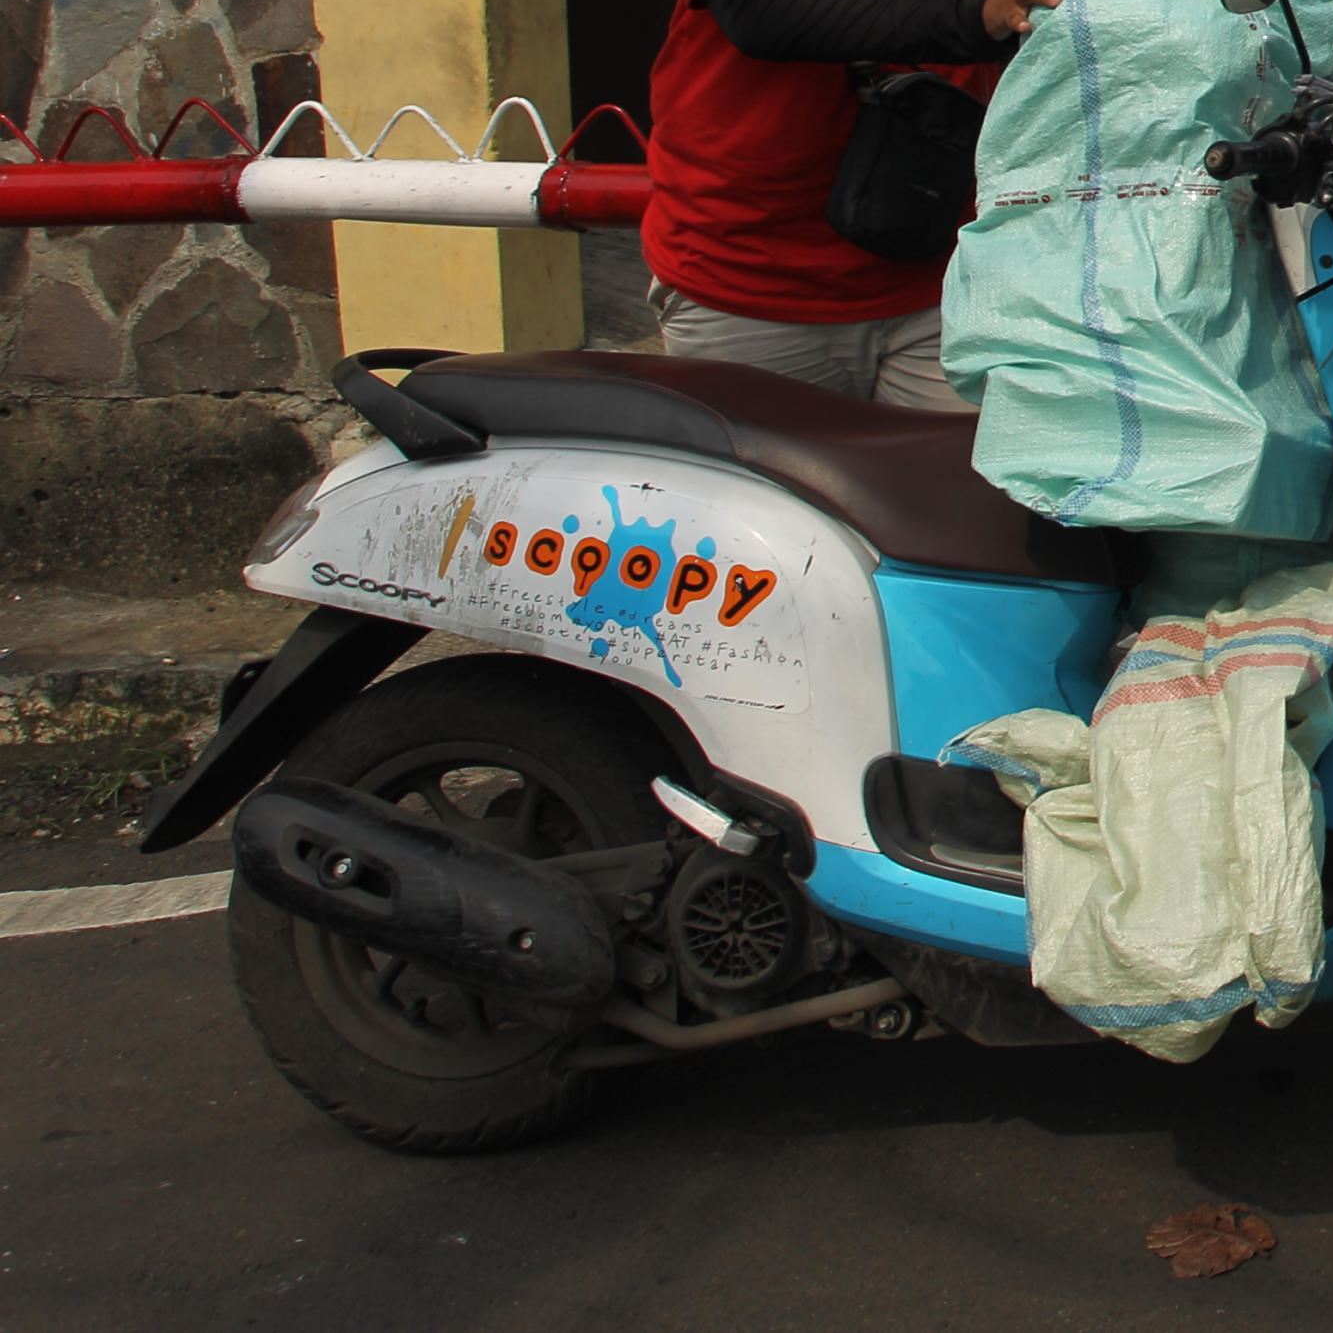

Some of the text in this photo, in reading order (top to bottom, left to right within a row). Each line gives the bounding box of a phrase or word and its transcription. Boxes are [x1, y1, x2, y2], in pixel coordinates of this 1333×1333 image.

[484, 521, 778, 627] SCOOPY
[488, 580, 605, 614] #Freestyle
[468, 592, 562, 623] #Freedom
[655, 632, 691, 648] #AT
[702, 639, 803, 668] #Fashion
